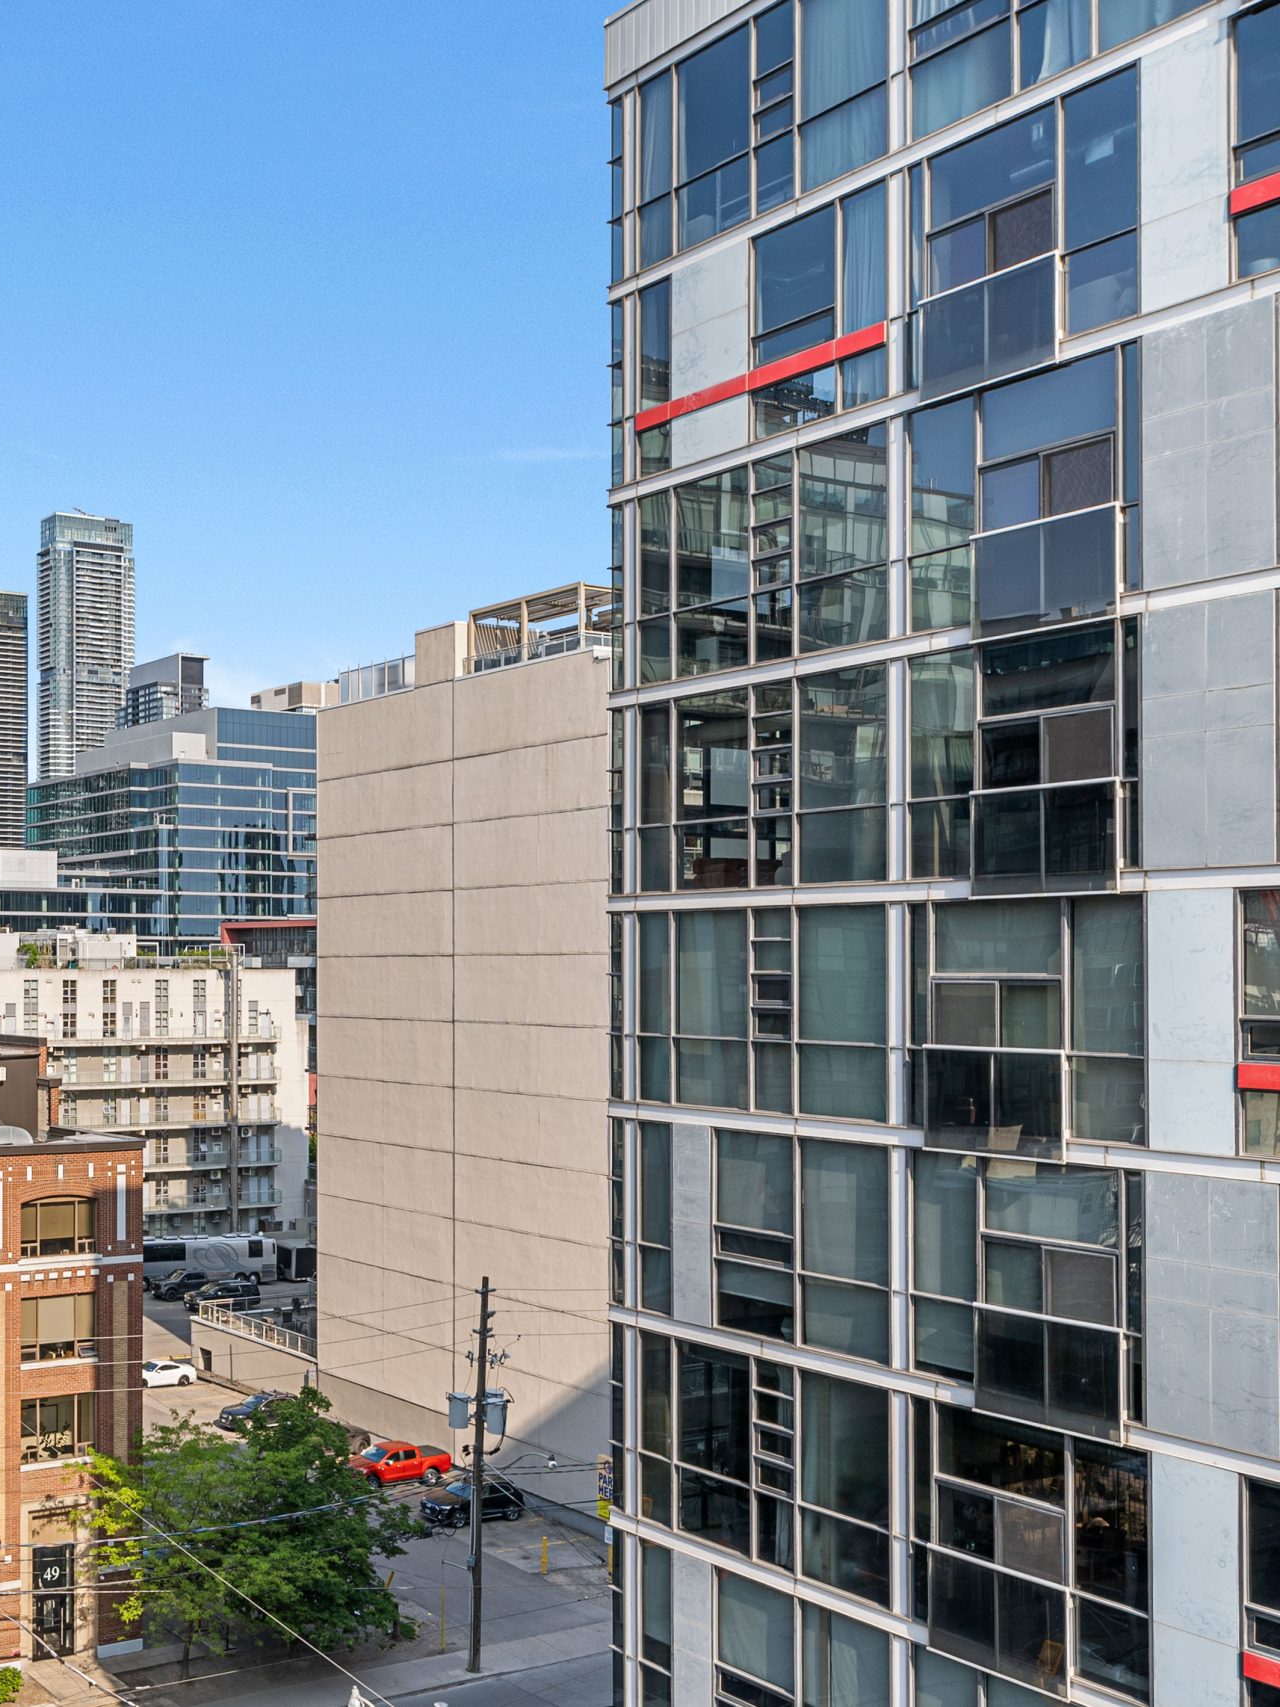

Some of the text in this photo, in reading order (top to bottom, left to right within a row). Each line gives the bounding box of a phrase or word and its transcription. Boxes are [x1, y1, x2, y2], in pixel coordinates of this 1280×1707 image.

[598, 1472, 613, 1488] PAR
[598, 1484, 613, 1498] HER
[43, 1566, 60, 1581] 49
